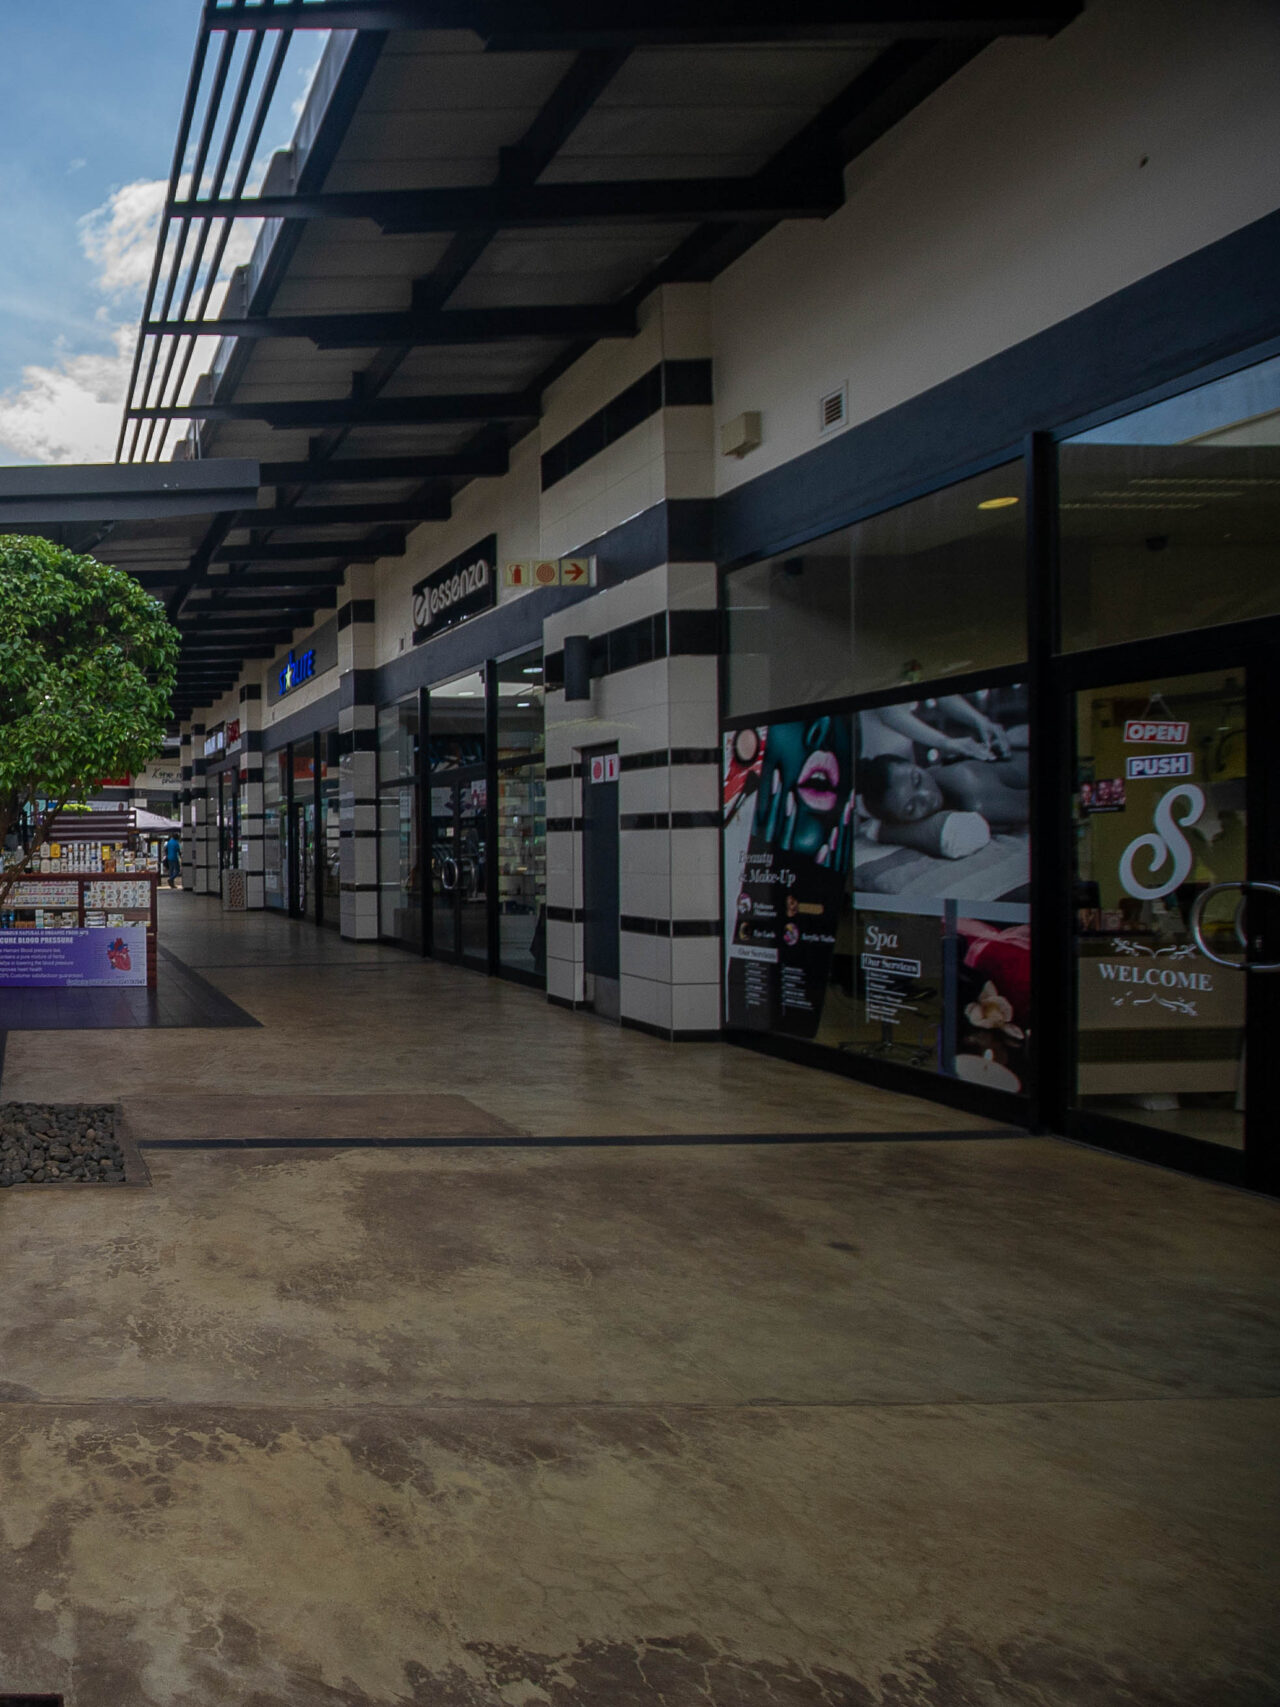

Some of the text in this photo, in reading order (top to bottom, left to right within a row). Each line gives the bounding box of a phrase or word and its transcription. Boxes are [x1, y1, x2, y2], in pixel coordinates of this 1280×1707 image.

[430, 559, 489, 614] essenza
[1127, 723, 1183, 742] OPEN
[1131, 756, 1185, 776] PUSH
[1118, 783, 1206, 900] S
[0, 936, 74, 944] CURE BLOOD PRESSURE
[865, 925, 899, 951] Spa
[1098, 962, 1214, 992] WELCOME
